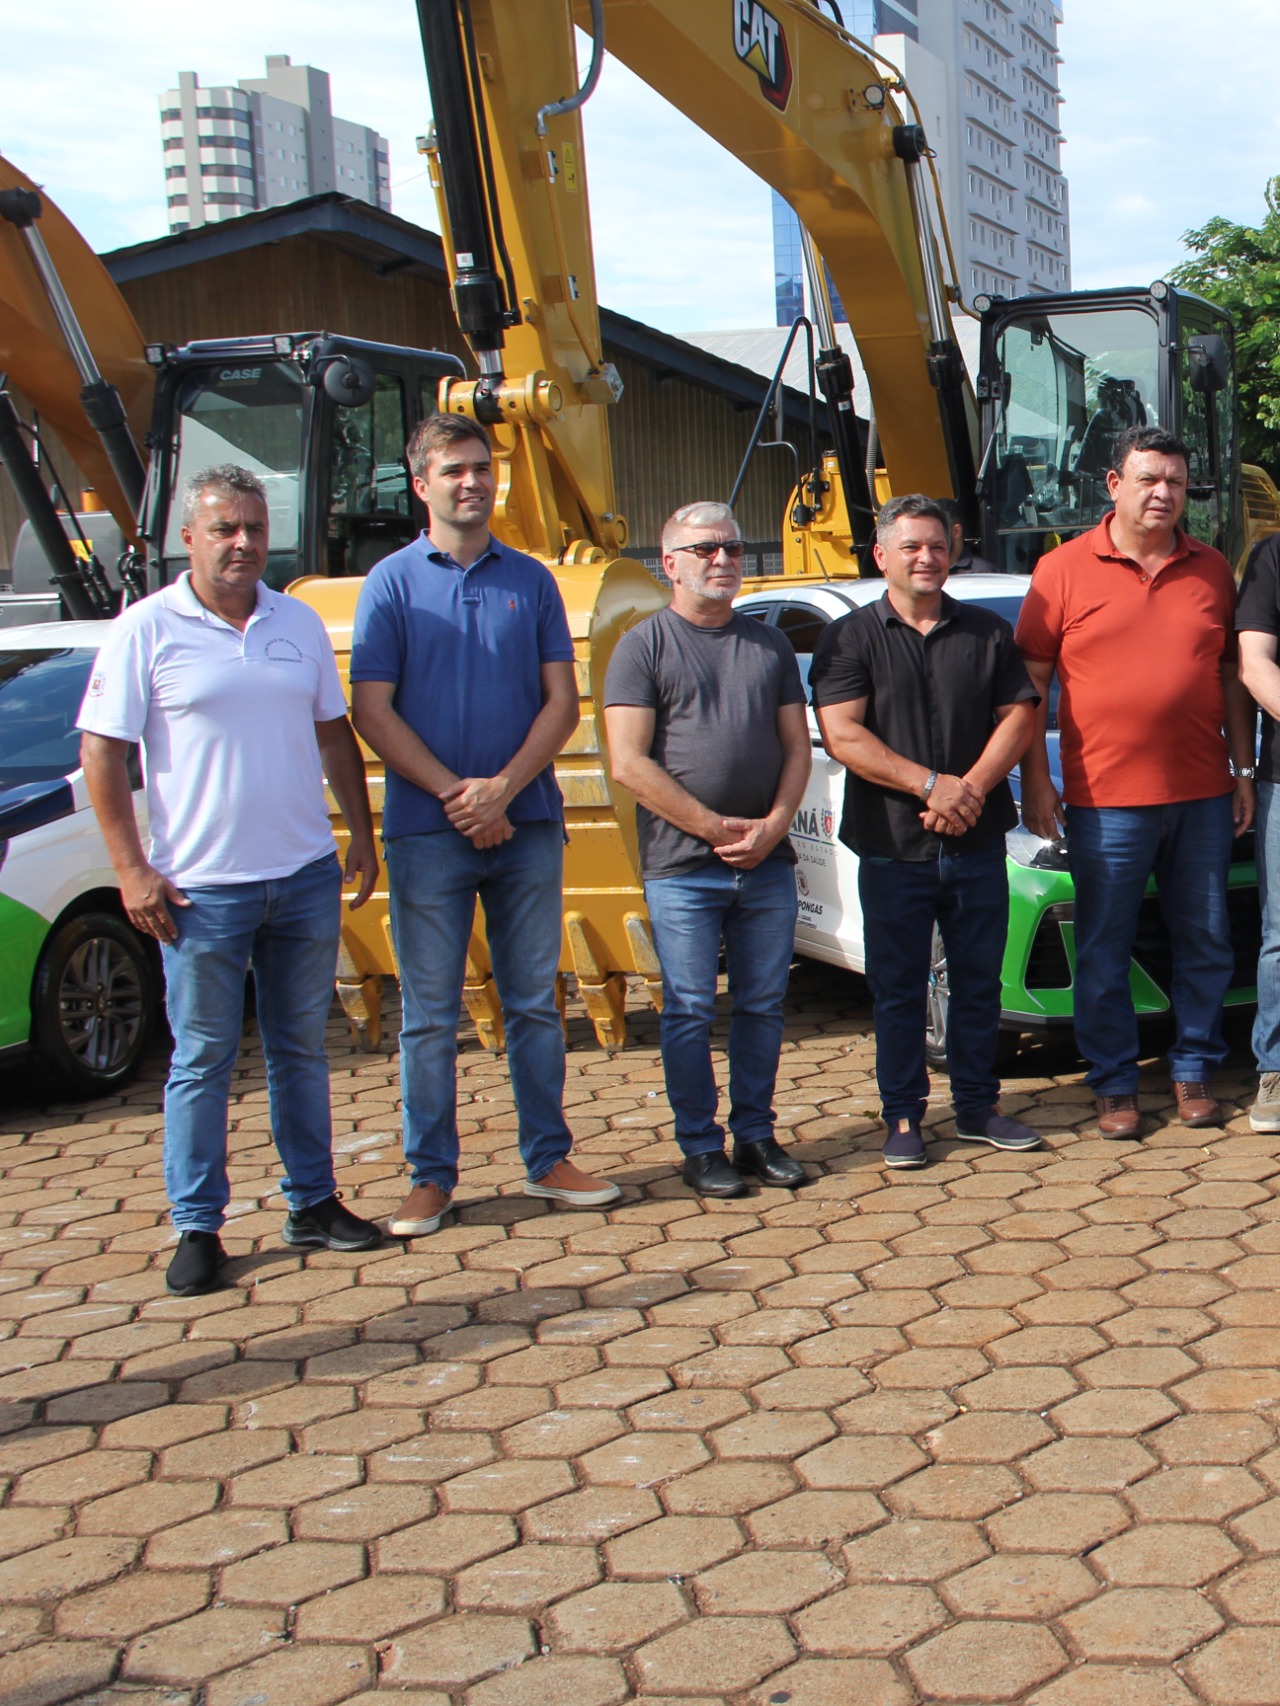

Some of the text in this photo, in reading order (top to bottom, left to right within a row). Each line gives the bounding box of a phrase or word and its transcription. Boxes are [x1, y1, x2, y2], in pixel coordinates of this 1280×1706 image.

[734, 0, 779, 84] CAT
[220, 368, 262, 380] CASE
[790, 808, 819, 837] ANÁ
[798, 900, 823, 915] PONGAS
